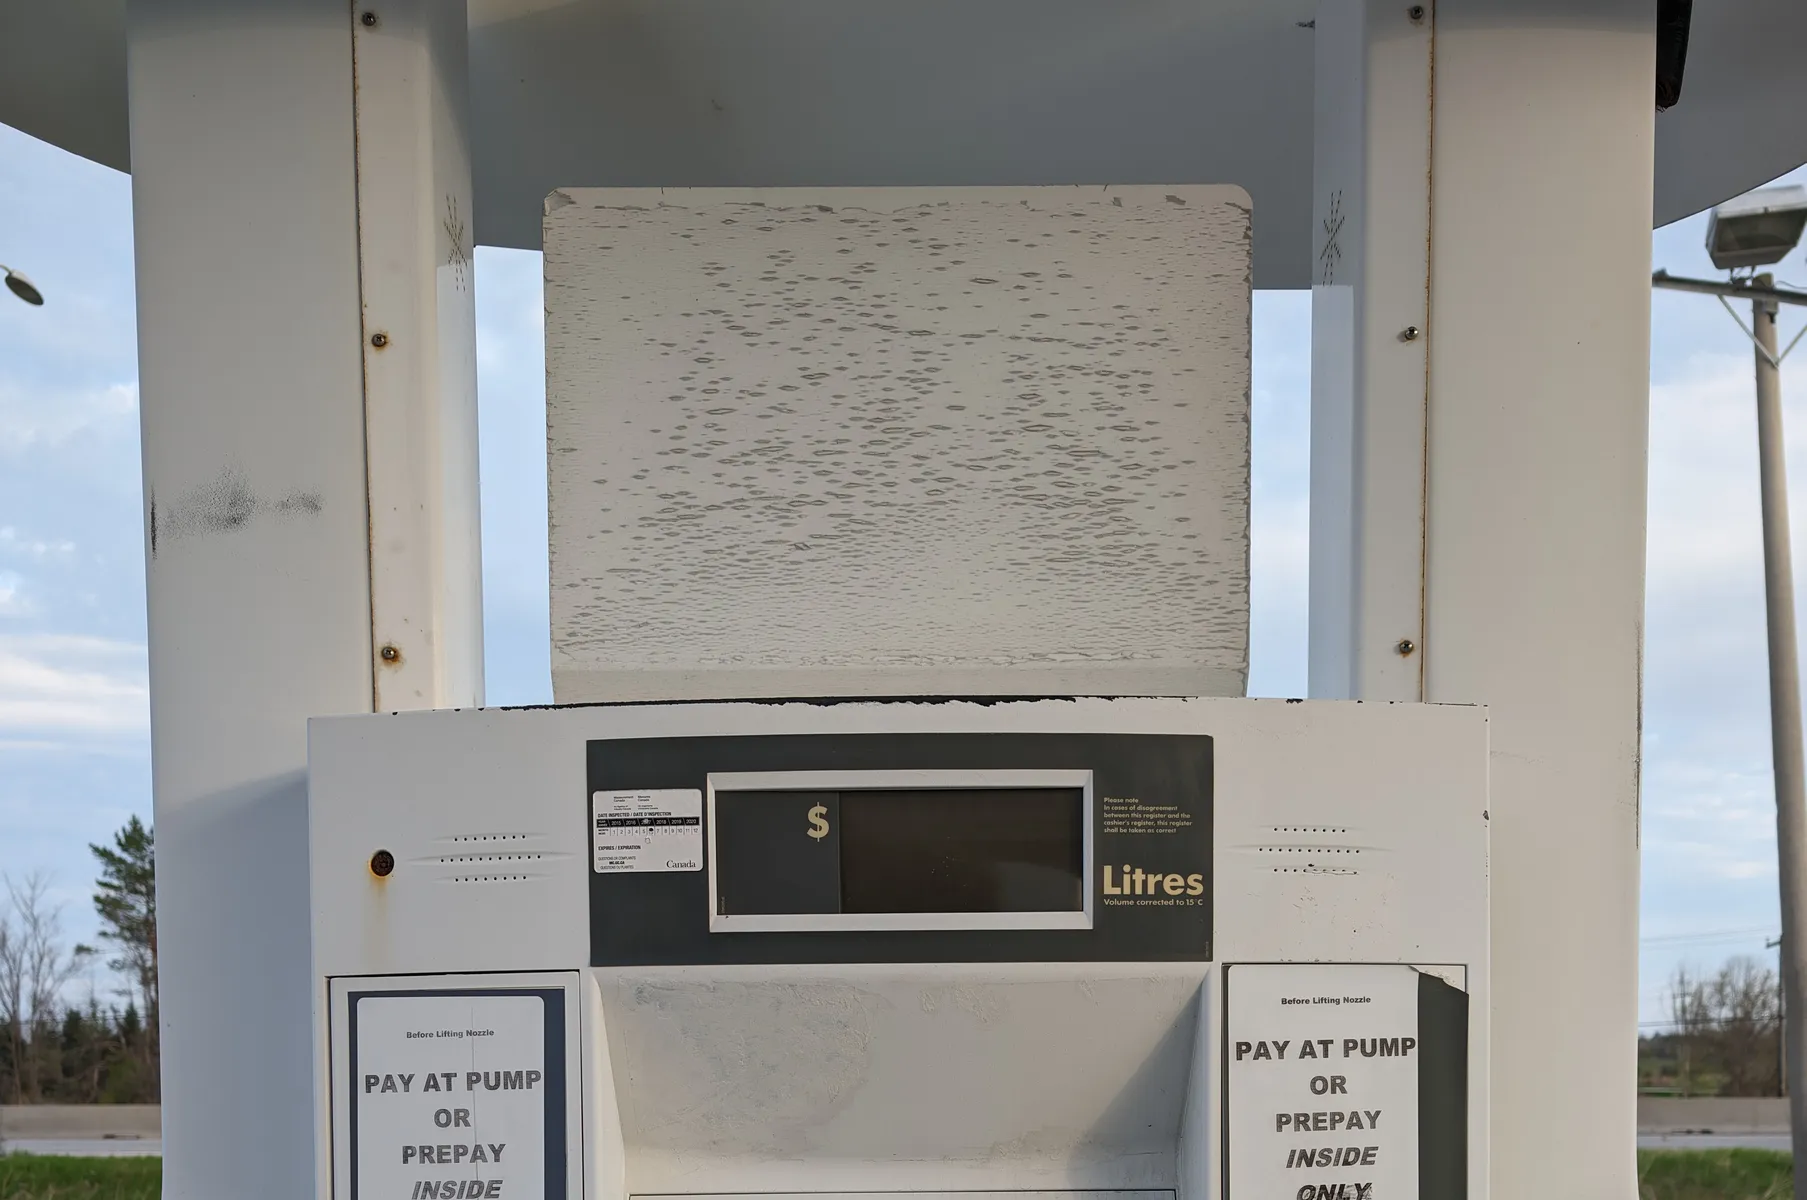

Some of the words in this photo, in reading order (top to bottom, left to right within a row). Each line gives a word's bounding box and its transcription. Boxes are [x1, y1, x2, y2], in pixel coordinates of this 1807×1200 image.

[806, 801, 829, 843] $
[666, 860, 696, 869] Canada
[1103, 864, 1203, 896] Litres
[1281, 997, 1310, 1005] Before
[1312, 996, 1340, 1005] Lifting
[1342, 996, 1371, 1004] Nozzle
[406, 1030, 435, 1039] Before
[436, 1029, 464, 1040] Lifting
[465, 1028, 494, 1037] Nozzle
[1235, 1040, 1290, 1061] PAY
[1299, 1039, 1333, 1059] AT
[1343, 1037, 1416, 1057] PUMP
[365, 1073, 416, 1094] PAY
[423, 1072, 458, 1091] AT
[467, 1070, 542, 1091] PUMP
[1310, 1075, 1348, 1095] OR
[433, 1108, 471, 1128] OR
[1276, 1110, 1381, 1132] PREPAY
[402, 1143, 506, 1165] PREPAY
[1286, 1147, 1379, 1168] INSIDE
[411, 1179, 503, 1200] INSIDE
